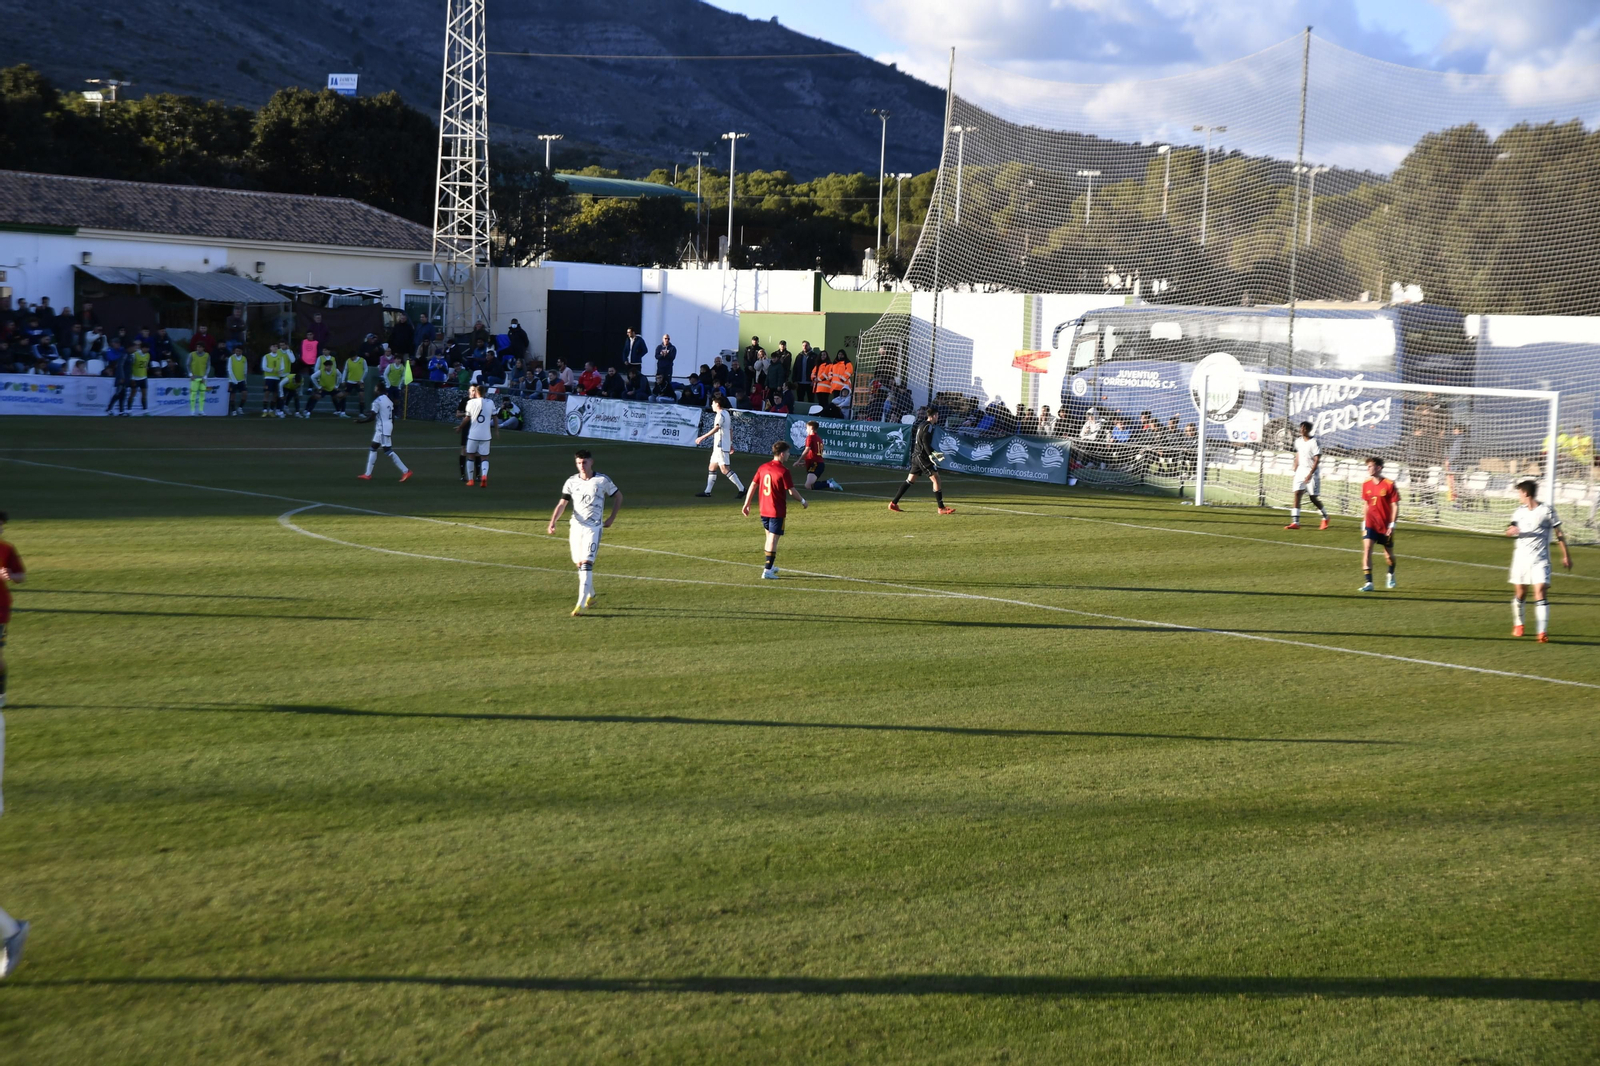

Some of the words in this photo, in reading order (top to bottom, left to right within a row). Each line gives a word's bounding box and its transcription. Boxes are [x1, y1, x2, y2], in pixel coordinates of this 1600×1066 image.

[1116, 369, 1159, 380] JUVENTUD
[1098, 376, 1161, 388] ORREMOLINOS
[476, 409, 486, 424] 6
[630, 410, 647, 419] bizum
[817, 420, 843, 430] ESCADOS
[849, 423, 881, 433] MARISCOS
[877, 443, 884, 451] 13
[763, 473, 772, 497] 9
